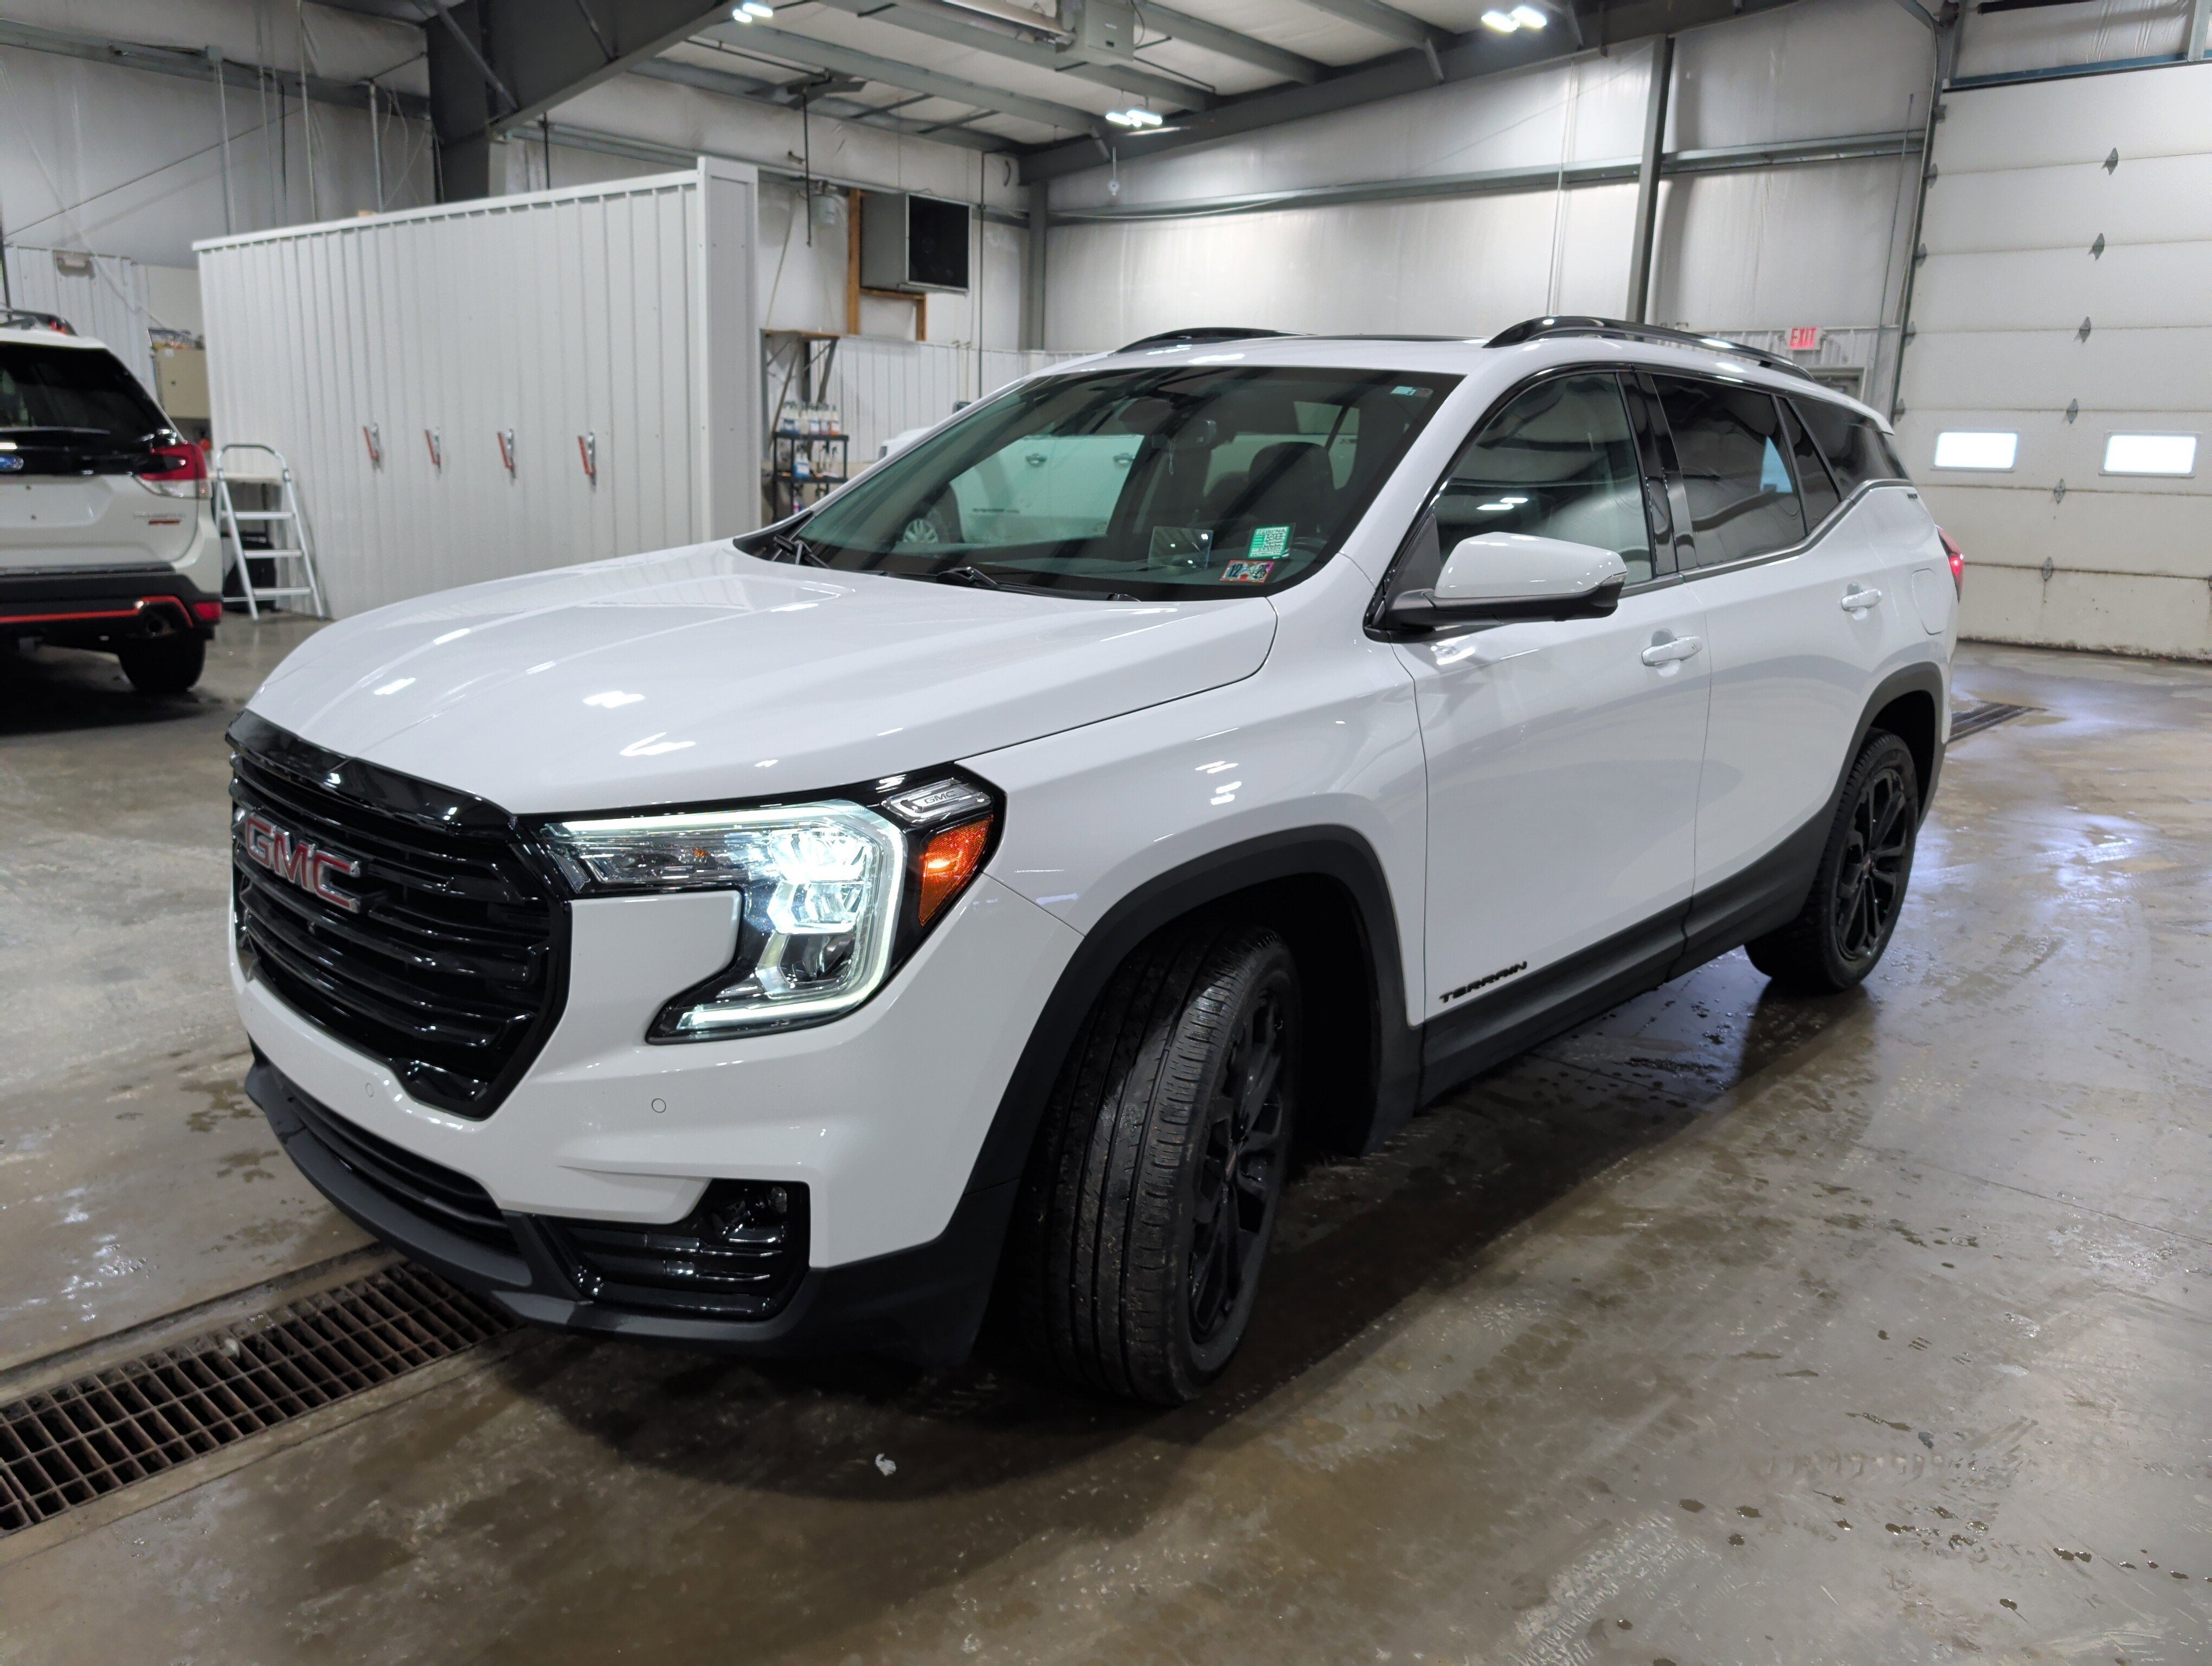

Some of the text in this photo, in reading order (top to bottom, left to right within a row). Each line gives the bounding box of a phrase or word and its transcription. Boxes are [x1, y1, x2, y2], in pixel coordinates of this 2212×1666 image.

[1790, 328, 1816, 347] EXIT
[1228, 563, 1243, 577] 12
[924, 790, 957, 804] GMC
[244, 810, 362, 914] GMC
